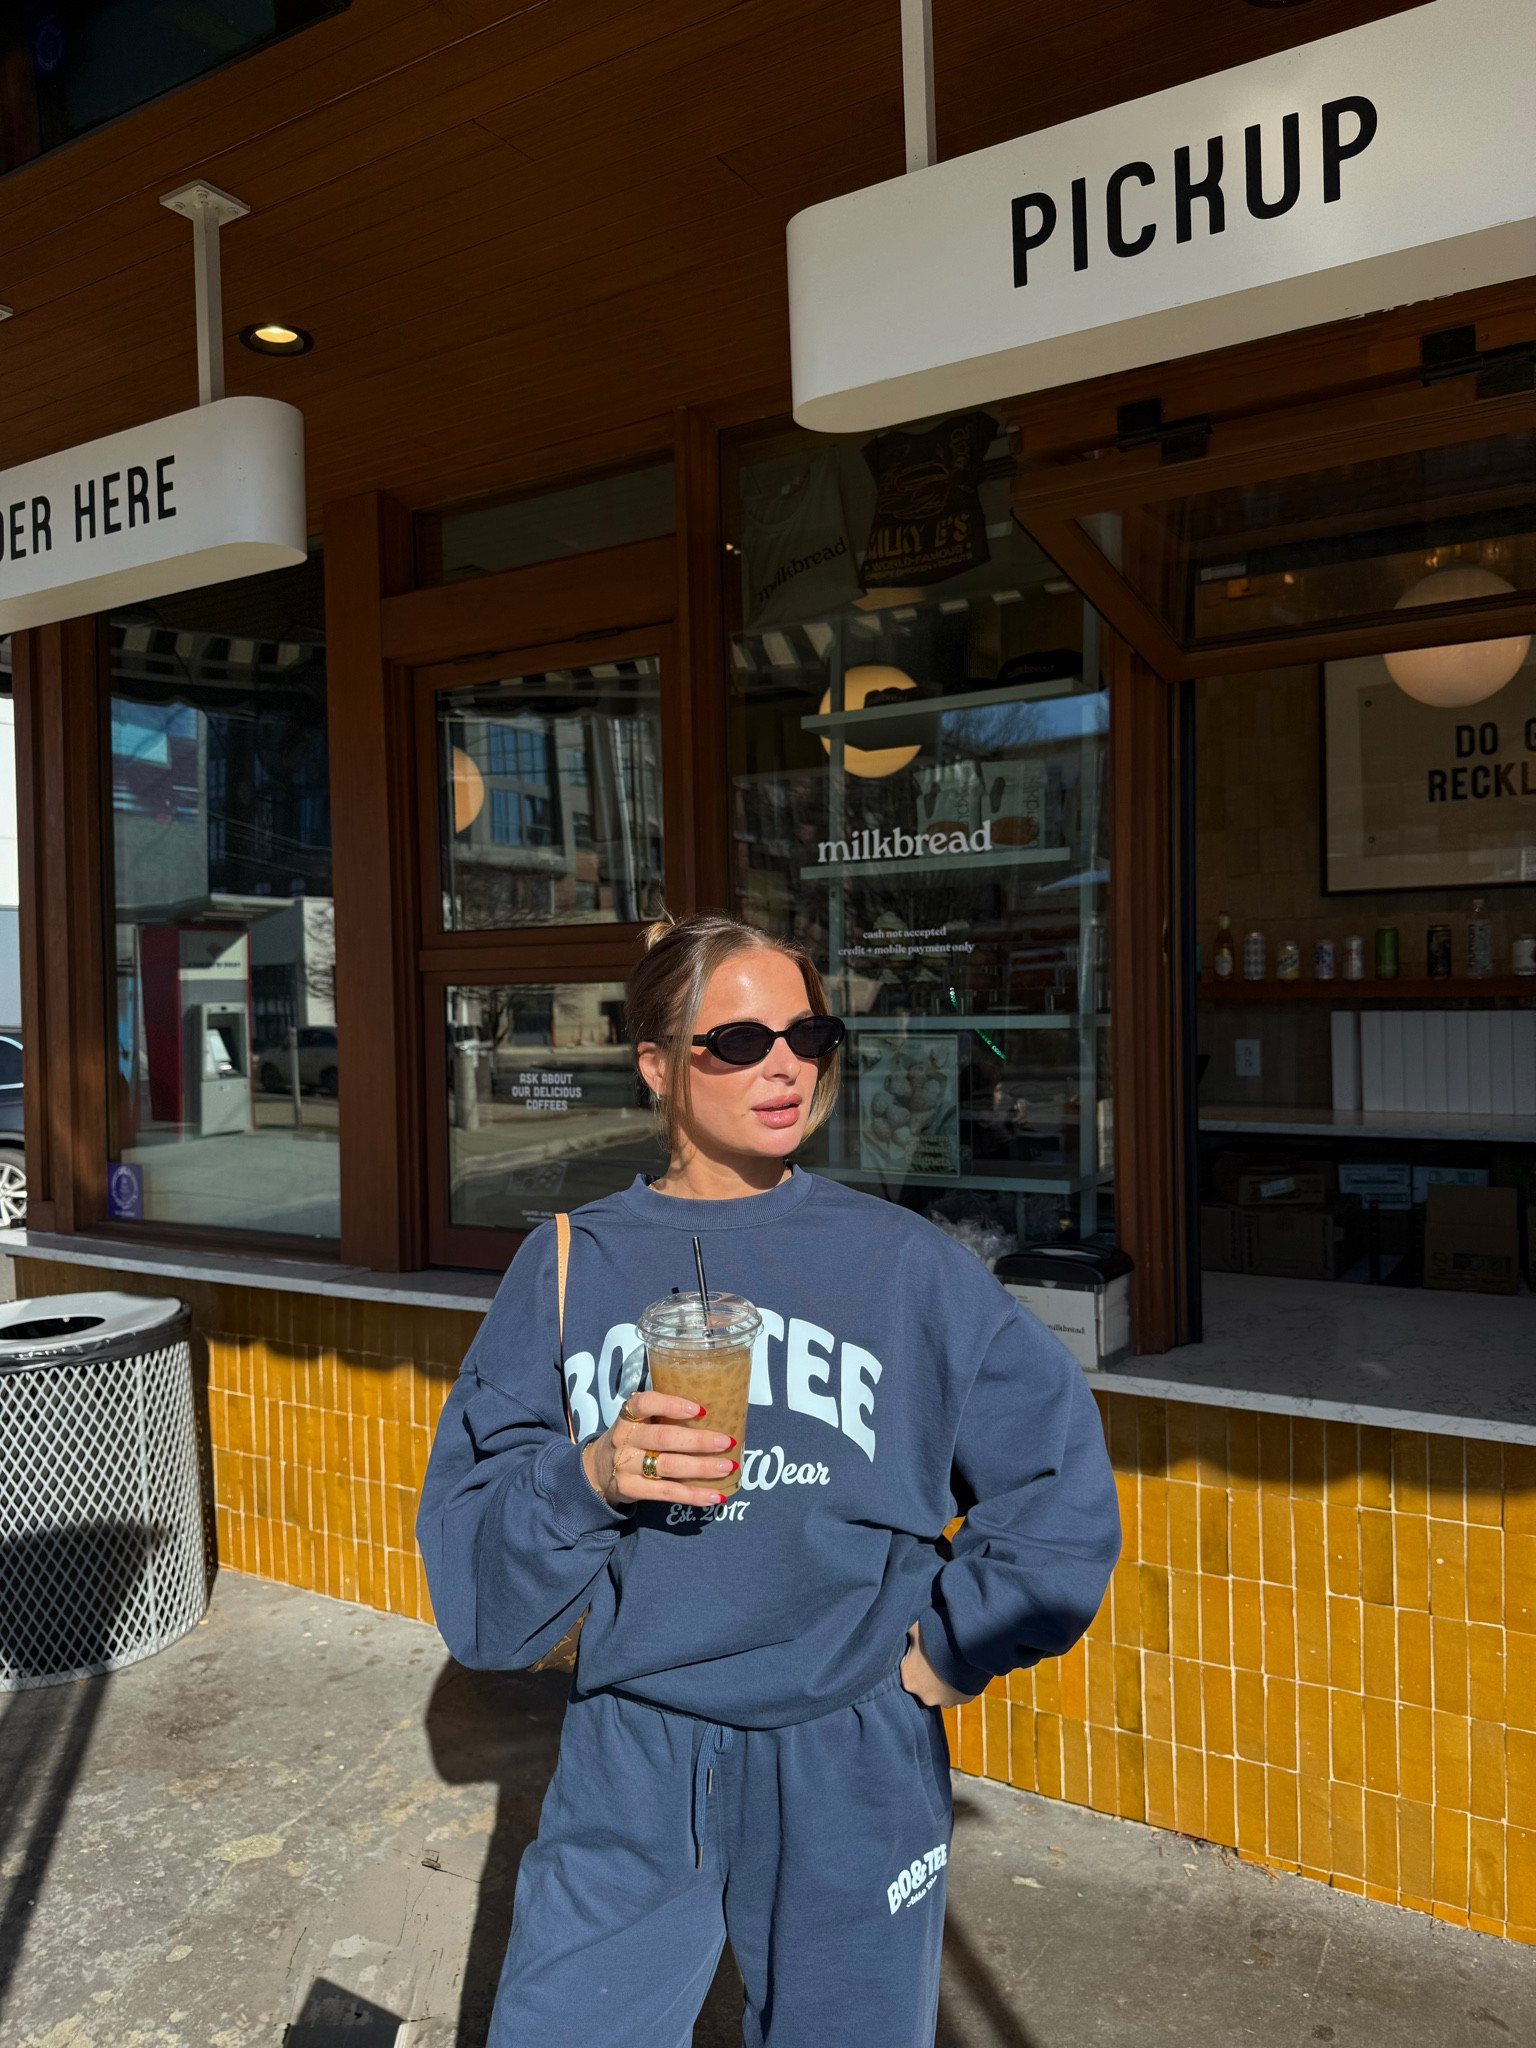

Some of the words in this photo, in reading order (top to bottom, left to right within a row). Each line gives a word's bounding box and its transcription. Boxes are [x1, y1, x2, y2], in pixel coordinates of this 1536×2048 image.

[1011, 95, 1379, 289] PICKUP
[0, 495, 52, 563] ER
[74, 455, 177, 543] HERE
[1456, 721, 1498, 758] DO
[1428, 761, 1536, 802] RECKL
[817, 819, 993, 863] milkbread
[838, 945, 865, 956] credit
[874, 944, 906, 955] mobile
[907, 943, 951, 956] payment
[951, 941, 975, 954] only
[863, 929, 885, 939] cash
[886, 930, 903, 938] not
[904, 926, 947, 939] accepted
[511, 1086, 531, 1097] OUR
[533, 1086, 582, 1098] DELICIOUS
[519, 1073, 539, 1084] ASK
[541, 1073, 573, 1085] ABOUT
[526, 1100, 568, 1111] COFFEES
[563, 1307, 883, 1464] BOTEE
[740, 1445, 831, 1491] Wear
[665, 1503, 696, 1526] Est.
[700, 1500, 751, 1522] 2017
[886, 1843, 948, 1915] BO&TEE
